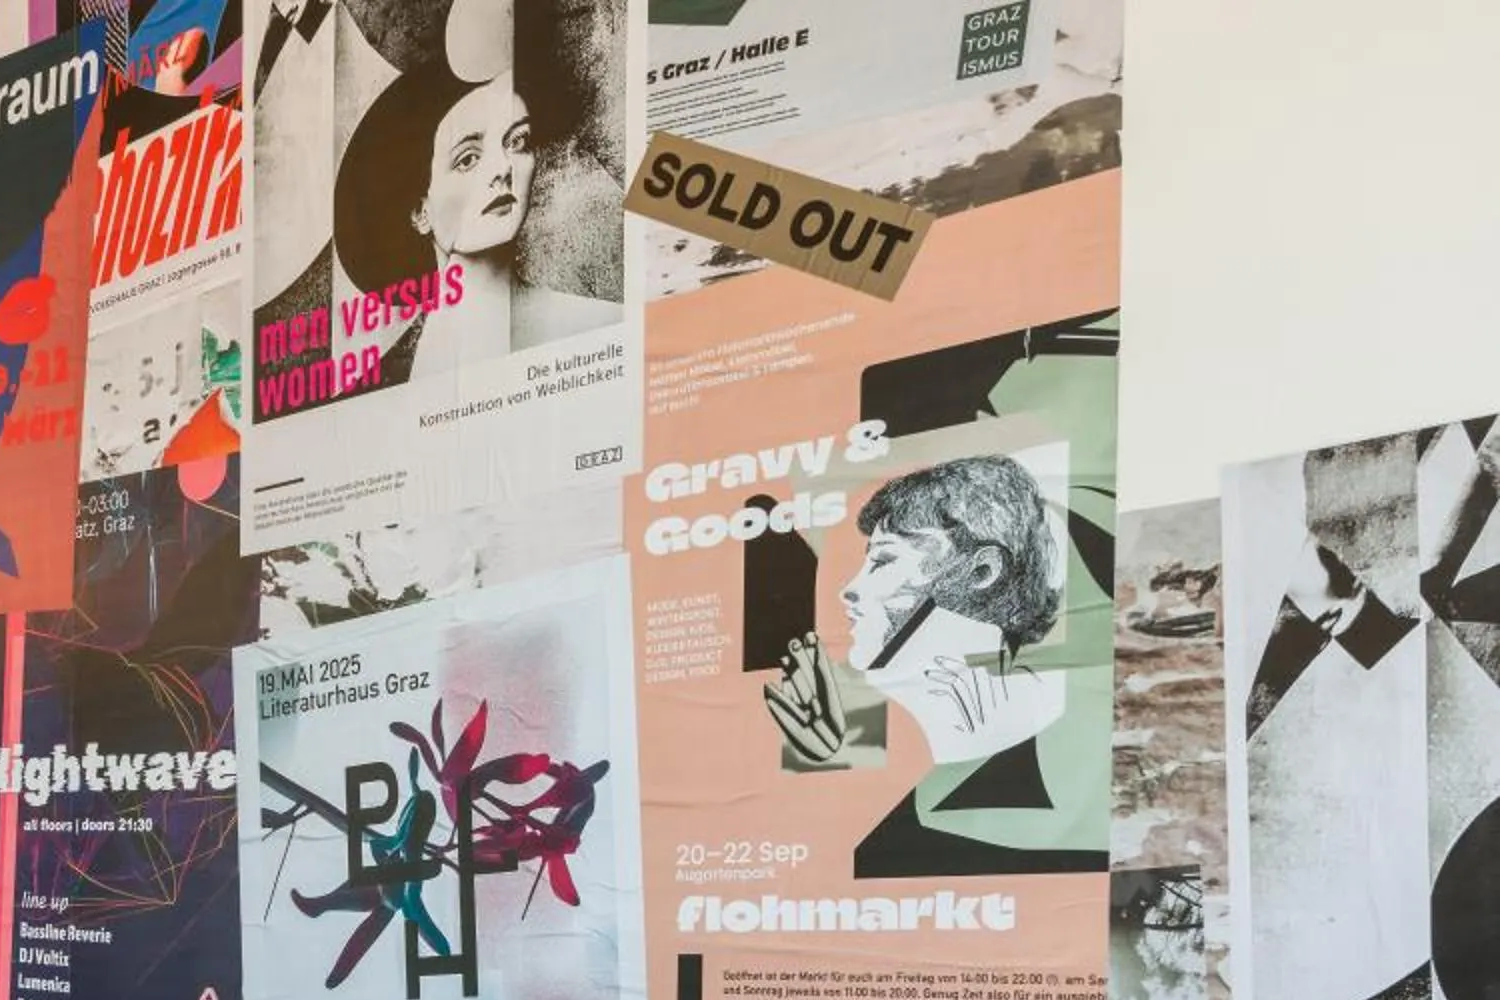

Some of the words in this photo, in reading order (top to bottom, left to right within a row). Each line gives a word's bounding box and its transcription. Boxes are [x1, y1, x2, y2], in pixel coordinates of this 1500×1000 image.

[967, 5, 1023, 32] GRAZ
[662, 55, 711, 81] Graz
[730, 35, 790, 64] Halle
[795, 28, 809, 48] E
[964, 27, 1019, 53] TOUR
[962, 50, 1019, 76] ISMUS
[643, 151, 781, 232] SOLD
[789, 199, 913, 274] OUT
[259, 303, 329, 365] men
[341, 263, 466, 338] versus
[527, 366, 550, 382] Die
[555, 342, 624, 373] kulturelle
[259, 343, 382, 418] women
[419, 396, 504, 429] Konstruktion
[507, 388, 532, 405] von
[535, 363, 624, 401] Weiblichkeit
[644, 433, 835, 502] Gravy
[103, 514, 135, 534] Graz
[643, 489, 847, 555] Goods
[320, 654, 362, 685] 2025
[260, 681, 381, 720] Literaturhaus
[385, 670, 431, 696] Graz
[40, 818, 73, 832] floors
[81, 818, 115, 832] doors
[117, 818, 153, 833] 21:30
[759, 841, 809, 872] Sep
[675, 866, 777, 886] Augartenpark
[676, 891, 1016, 934] flohmarkt
[20, 923, 67, 941] Bassline
[67, 925, 113, 945] Reverie
[19, 948, 33, 964] DJ
[33, 950, 70, 968] Voltix
[18, 975, 71, 994] Lumenica
[923, 988, 959, 1000] Genug
[961, 988, 984, 1000] Zeit
[987, 989, 1011, 1000] also
